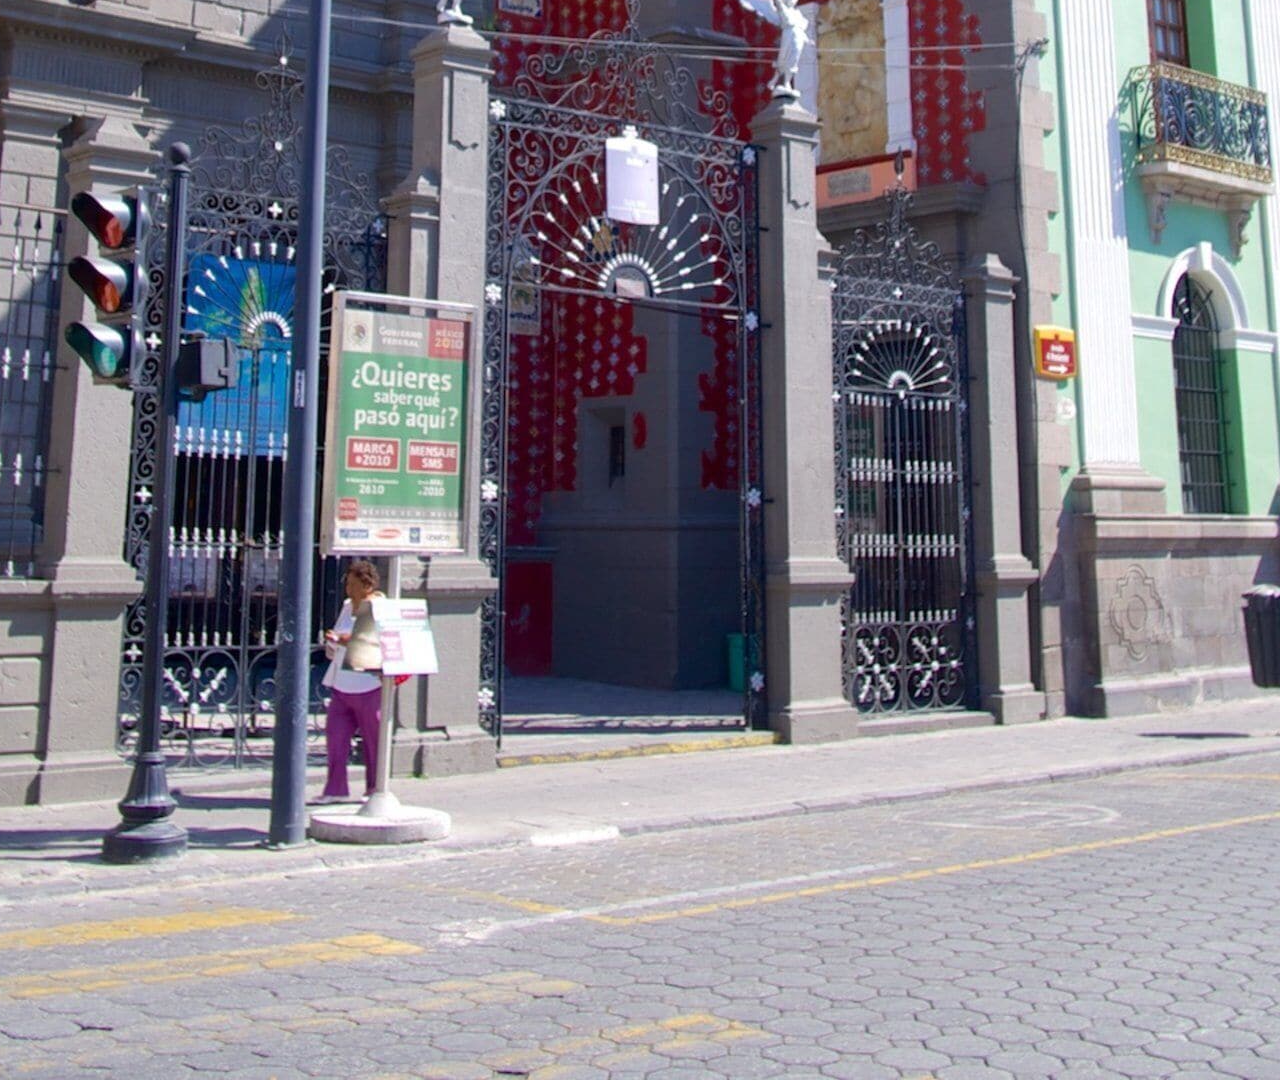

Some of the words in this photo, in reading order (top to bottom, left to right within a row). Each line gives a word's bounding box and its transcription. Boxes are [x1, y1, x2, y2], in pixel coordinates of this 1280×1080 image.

[435, 339, 464, 349] 2010
[351, 361, 452, 392] ¿Quieres
[374, 389, 413, 405] saber
[414, 392, 441, 411] qué
[354, 405, 400, 431] pasó
[405, 407, 459, 435] aquí?
[352, 442, 394, 455] MARCA
[409, 445, 456, 458] MENSAJE
[422, 458, 443, 469] SMS
